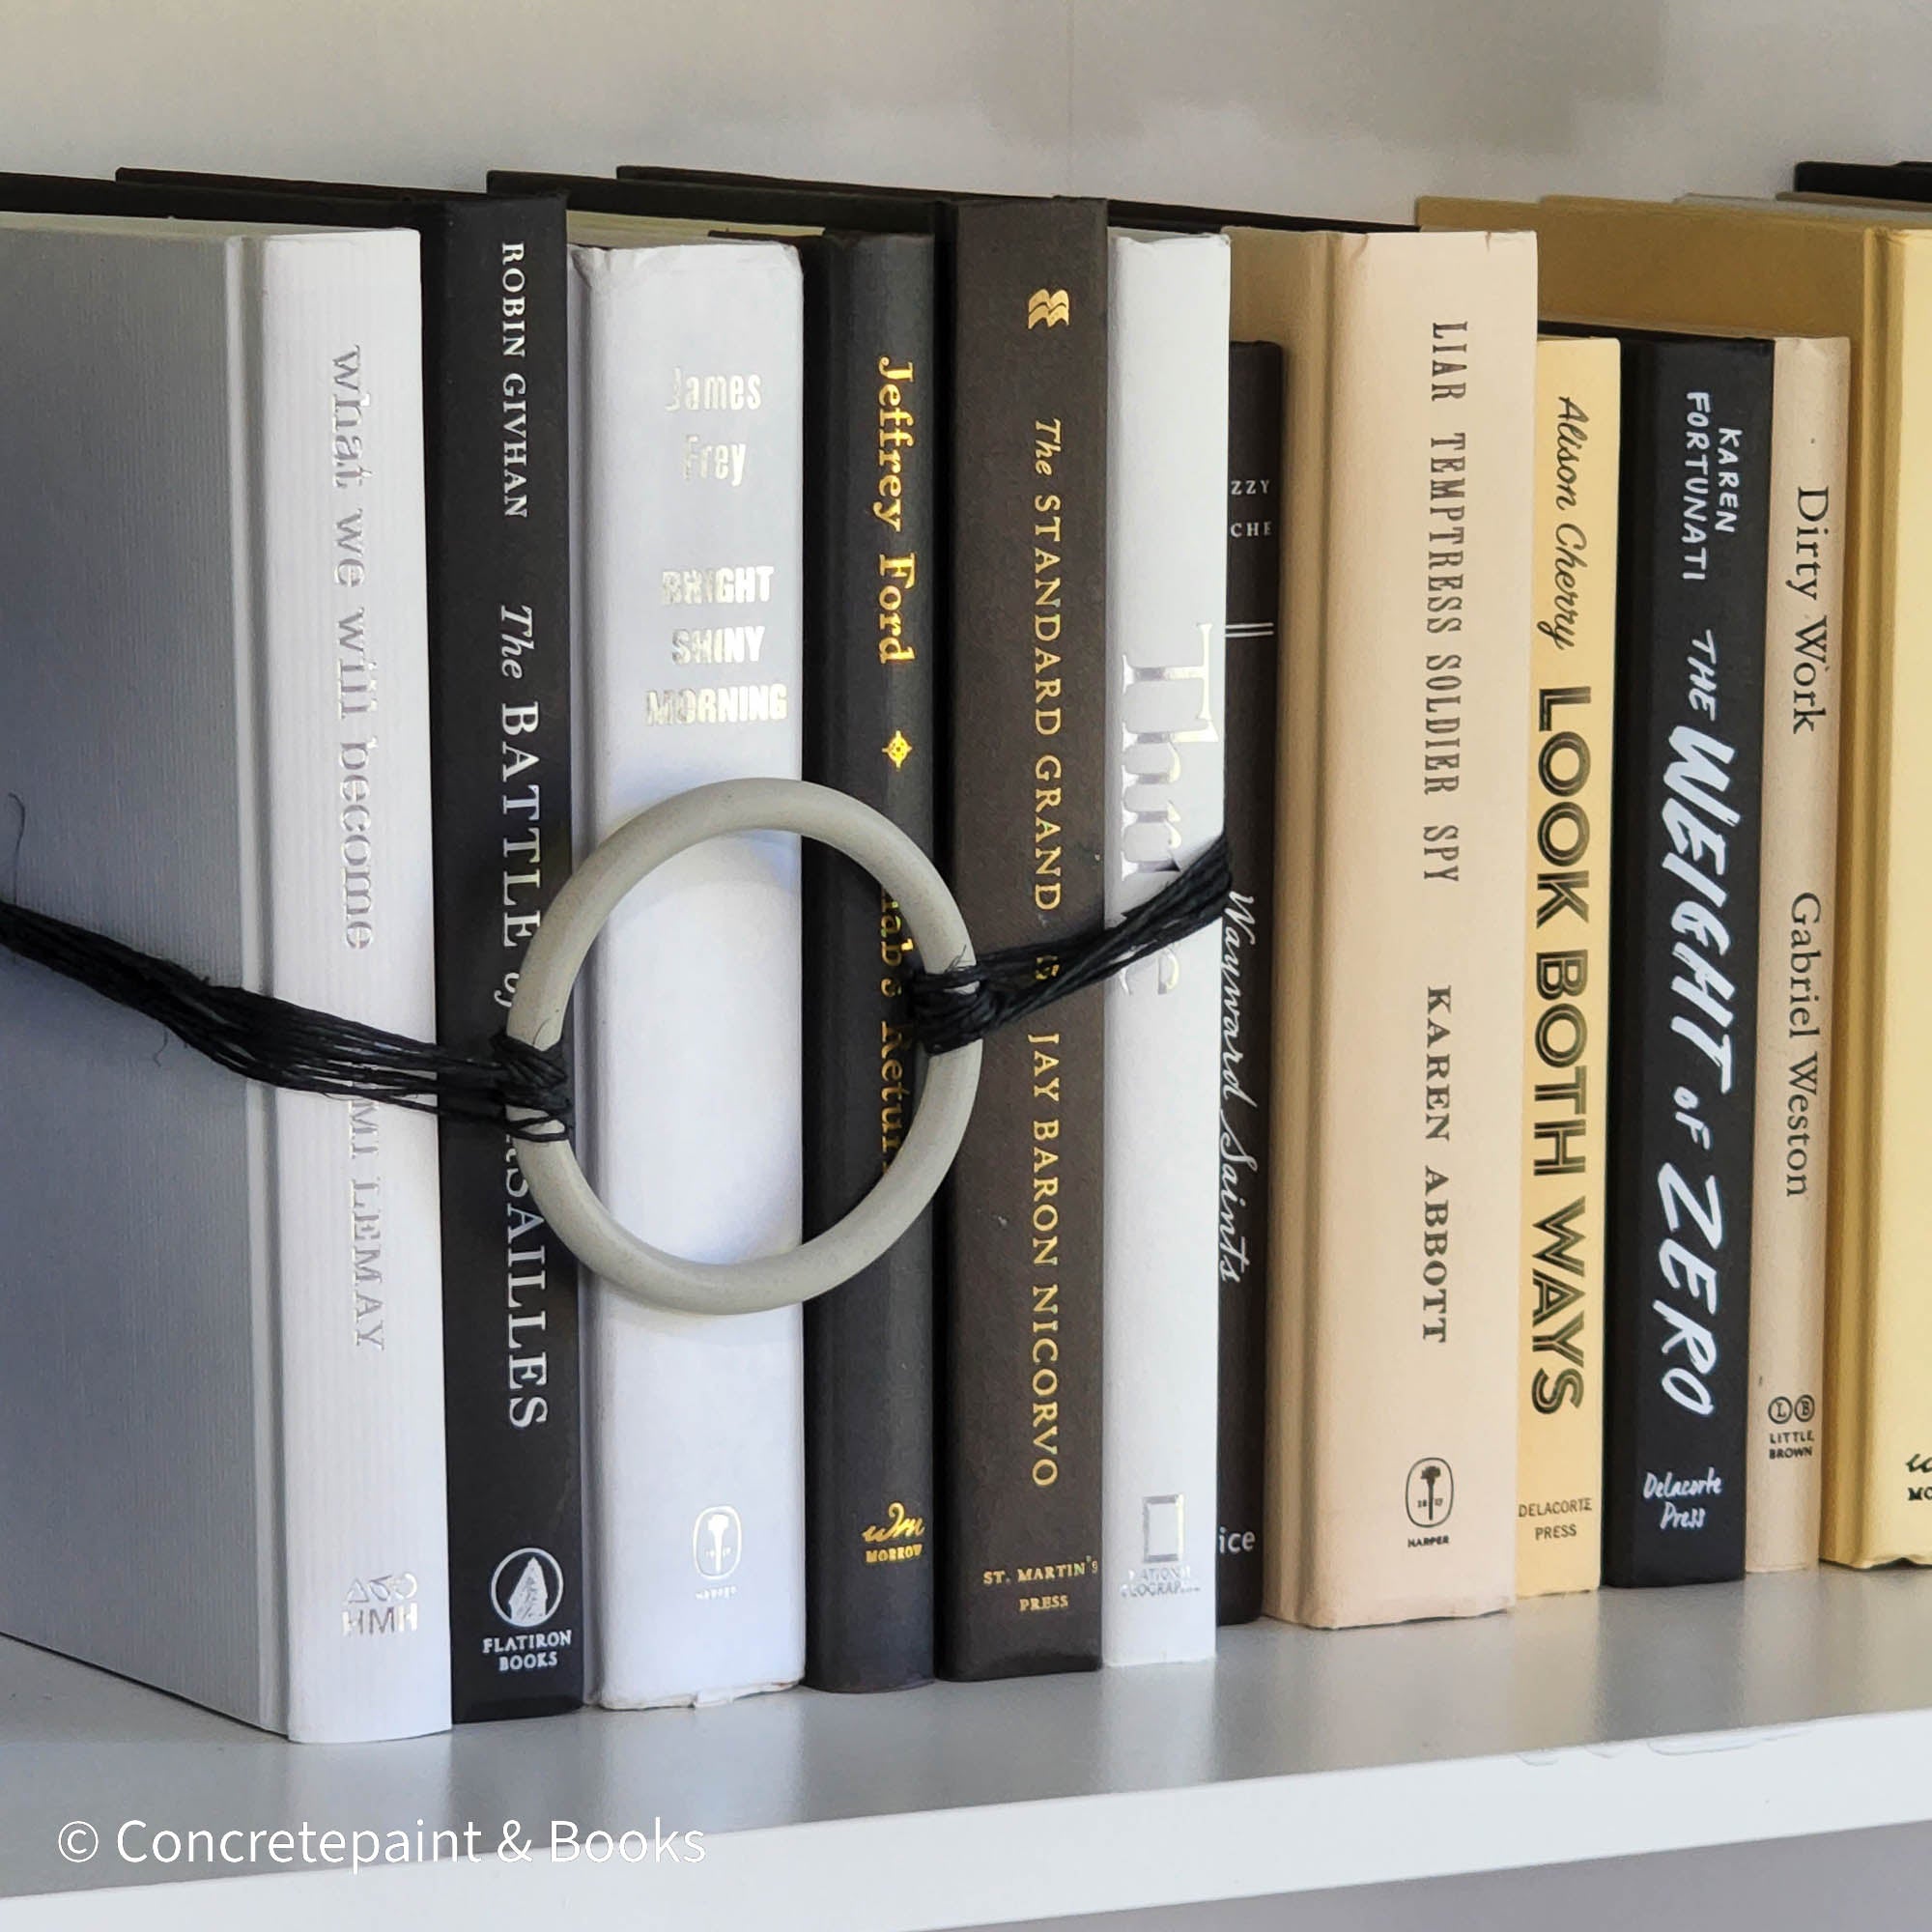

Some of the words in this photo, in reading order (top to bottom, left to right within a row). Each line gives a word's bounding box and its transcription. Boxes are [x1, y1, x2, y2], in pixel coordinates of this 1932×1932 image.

[501, 242, 526, 357] ROBIN
[332, 345, 373, 489] what
[665, 367, 761, 412] James
[1432, 321, 1468, 402] LIAR
[502, 372, 528, 519] GIVHAN
[684, 435, 747, 486] Frey
[873, 356, 915, 532] Jeffrey
[1034, 418, 1063, 477] The
[1557, 394, 1590, 512] Alison
[1681, 391, 1711, 581] FORTUNATI
[1714, 428, 1743, 532] KAREN
[334, 509, 365, 589] we
[660, 566, 774, 606] BRIGHT
[1427, 432, 1465, 634] TEMPTRESS
[1538, 524, 1589, 650] Cherry
[1786, 485, 1829, 601] Dirty
[338, 607, 378, 721] will
[500, 605, 533, 680] The
[671, 626, 765, 664] SHINY
[879, 554, 916, 664] Ford
[1034, 492, 1061, 736] STANDARD
[645, 682, 788, 726] MORNING
[1424, 654, 1463, 795] SOLDIER
[1688, 629, 1716, 721] THE
[1792, 615, 1828, 734] Work
[340, 736, 379, 951] become
[500, 701, 541, 949] BATTLE
[1035, 755, 1062, 910] GRAND
[1423, 825, 1460, 882] SPY
[1536, 686, 1592, 929] LOOK
[1660, 725, 1742, 1093] WEIGHT
[1789, 892, 1823, 1039] Gabriel
[1221, 890, 1258, 1109] Wayward
[1028, 1033, 1061, 1102] JAY
[1424, 985, 1452, 1143] KAREN
[1534, 949, 1589, 1178] BOTH
[1673, 1086, 1710, 1150] OF
[1785, 1051, 1820, 1199] Weston
[1031, 1121, 1061, 1267] BARON
[1218, 1108, 1259, 1284] Saints
[350, 1178, 386, 1352] LEMAY
[1421, 1165, 1450, 1344] ABBOTT
[1530, 1196, 1586, 1416] WAYS
[1651, 1162, 1723, 1416] ZERO
[1030, 1285, 1059, 1488] NICORVO
[1770, 1429, 1815, 1444] LITTLE
[1518, 1497, 1593, 1518] DELACORTE
[1642, 1466, 1723, 1499] Delacorte
[1769, 1445, 1812, 1460] BROWN
[866, 1544, 923, 1563] MORROW
[1407, 1535, 1450, 1548] HARPER
[1535, 1523, 1577, 1541] PRESS
[1660, 1501, 1707, 1530] Press
[341, 1603, 419, 1636] HMH
[982, 1570, 1011, 1585] ST.
[1019, 1594, 1069, 1612] PRESS
[482, 1630, 572, 1654] FLATIRON
[498, 1651, 558, 1672] BOOKS
